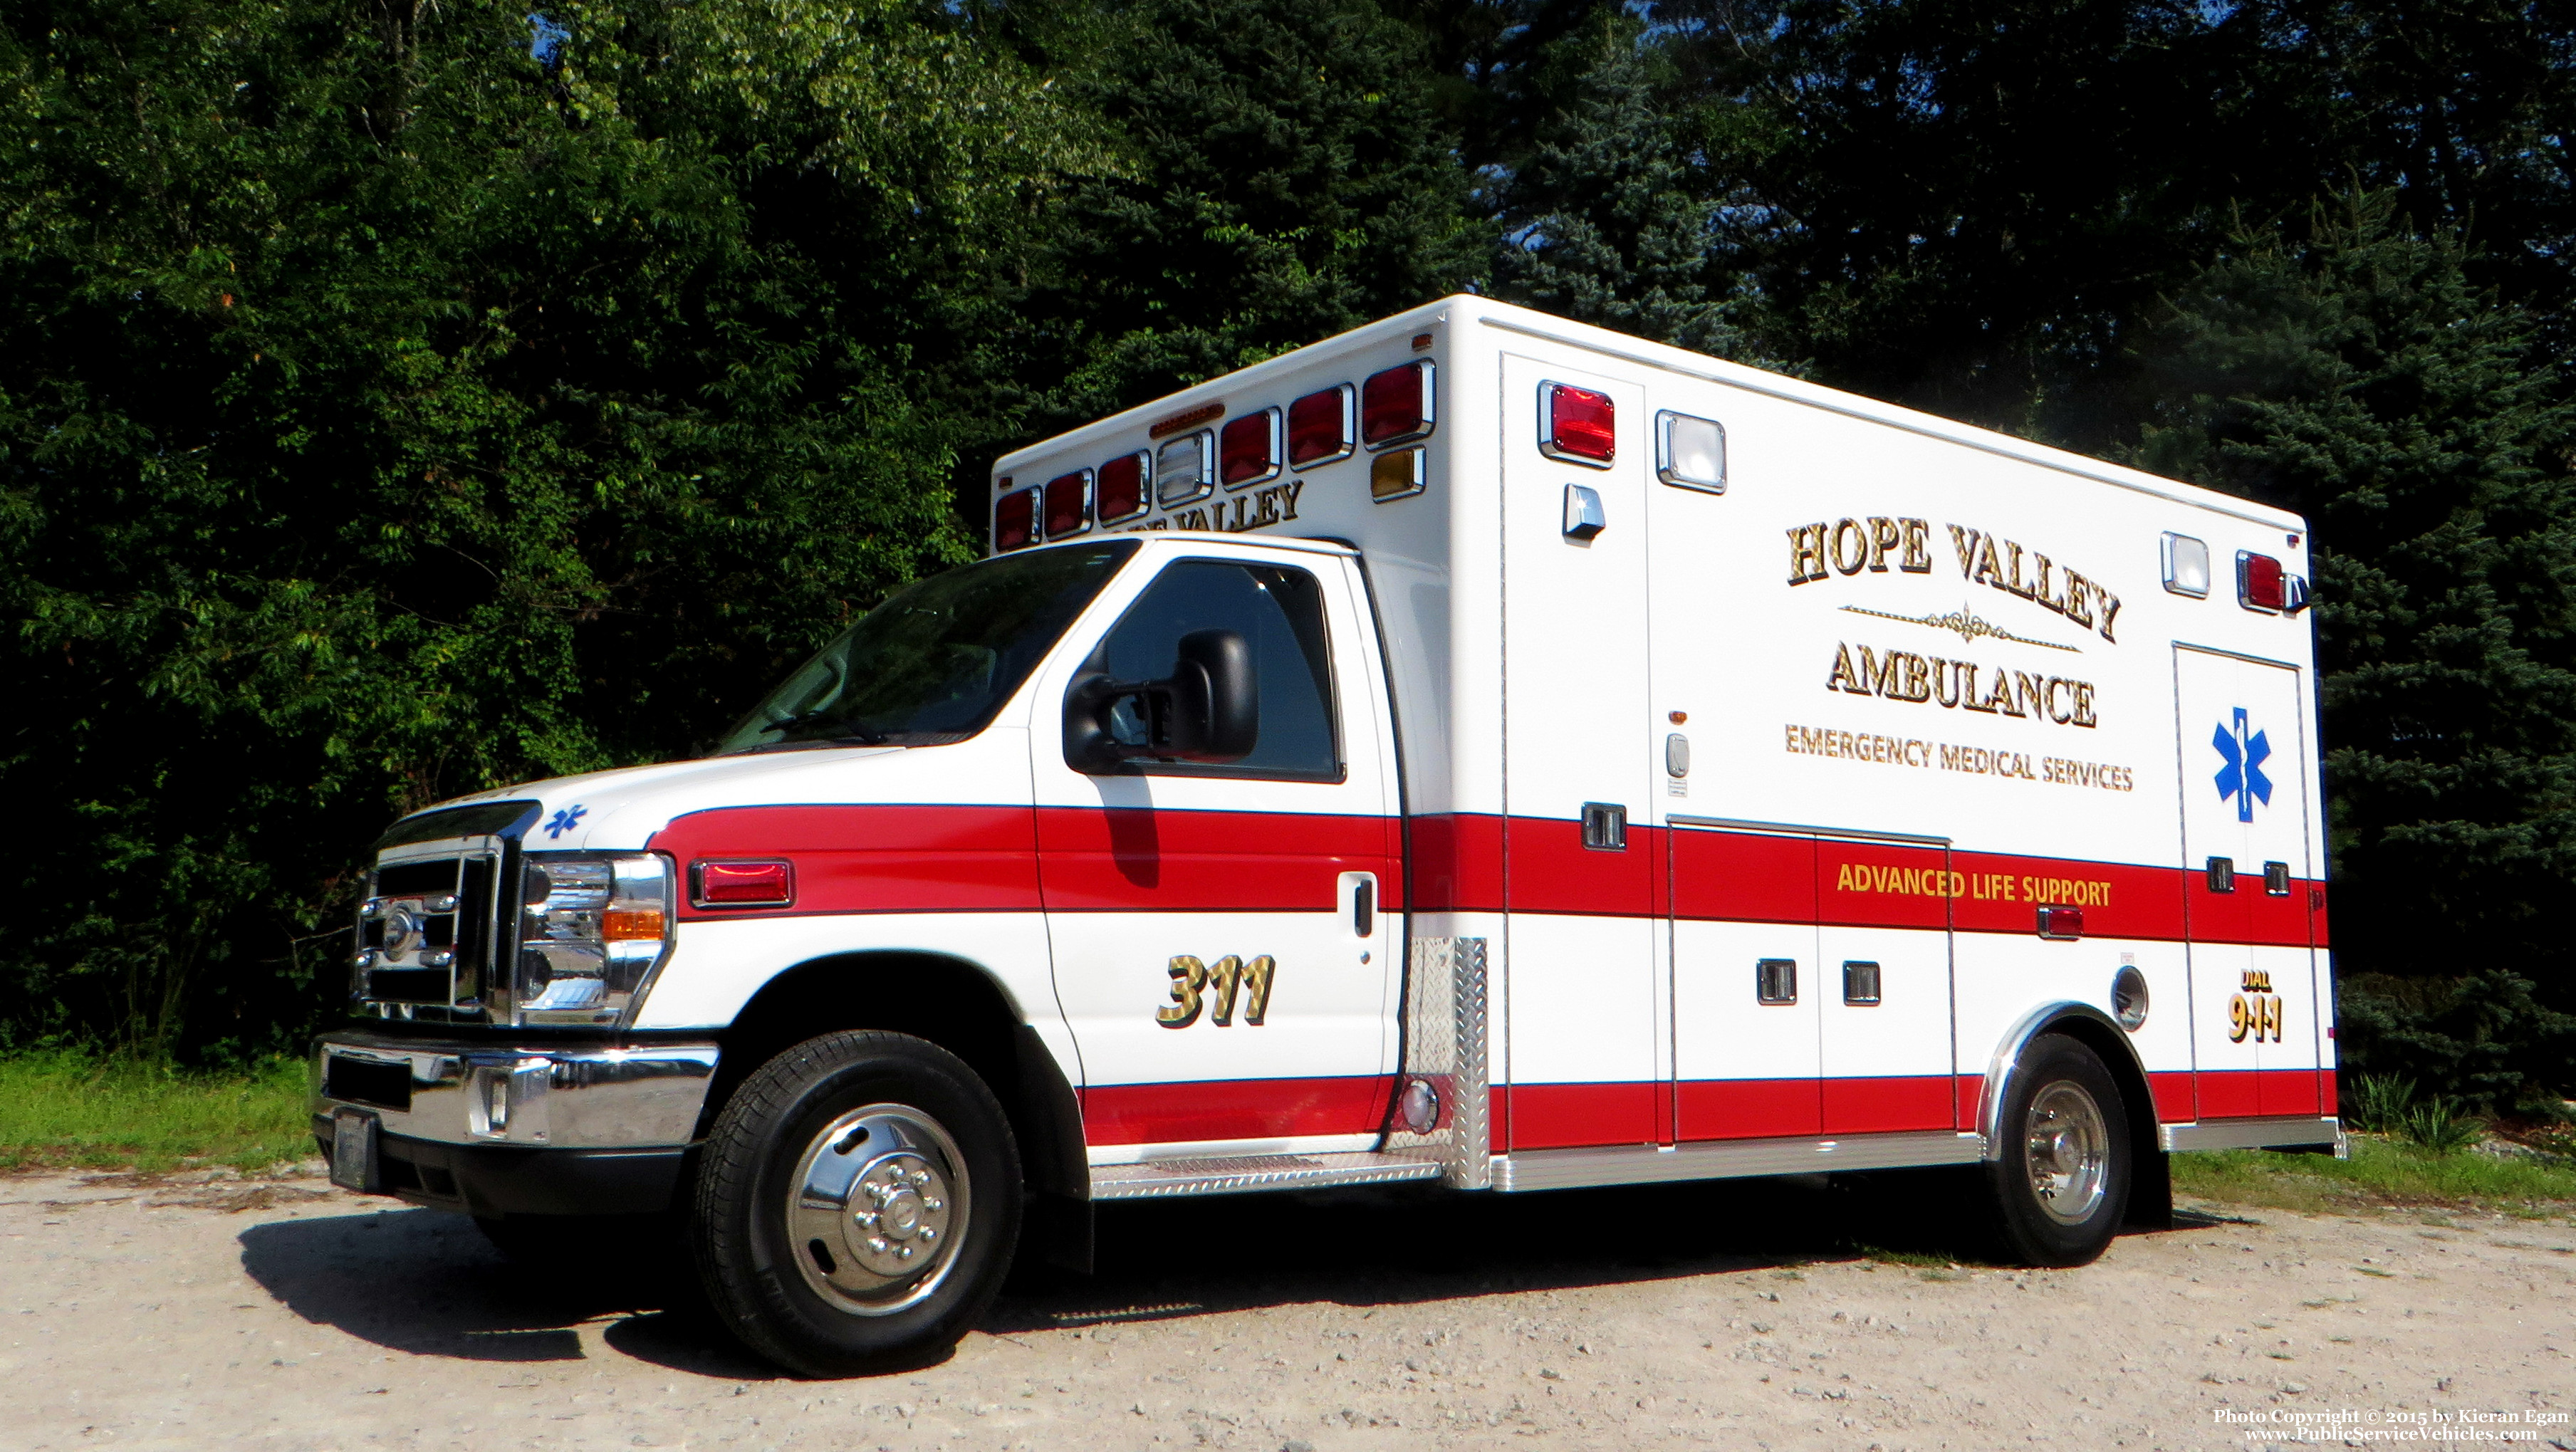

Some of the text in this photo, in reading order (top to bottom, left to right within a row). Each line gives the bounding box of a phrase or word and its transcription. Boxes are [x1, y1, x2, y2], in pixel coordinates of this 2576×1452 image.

[1785, 516, 2122, 644] HOPE VALLEY
[1825, 640, 2097, 728] AMBULANCE
[1785, 724, 2134, 792] EMERGENCY MEDICAL SERVICES
[1837, 863, 2111, 907] ADVANCED LIFE SUPPORT
[1156, 955, 1276, 1029] 311
[2241, 968, 2272, 993] DIAL
